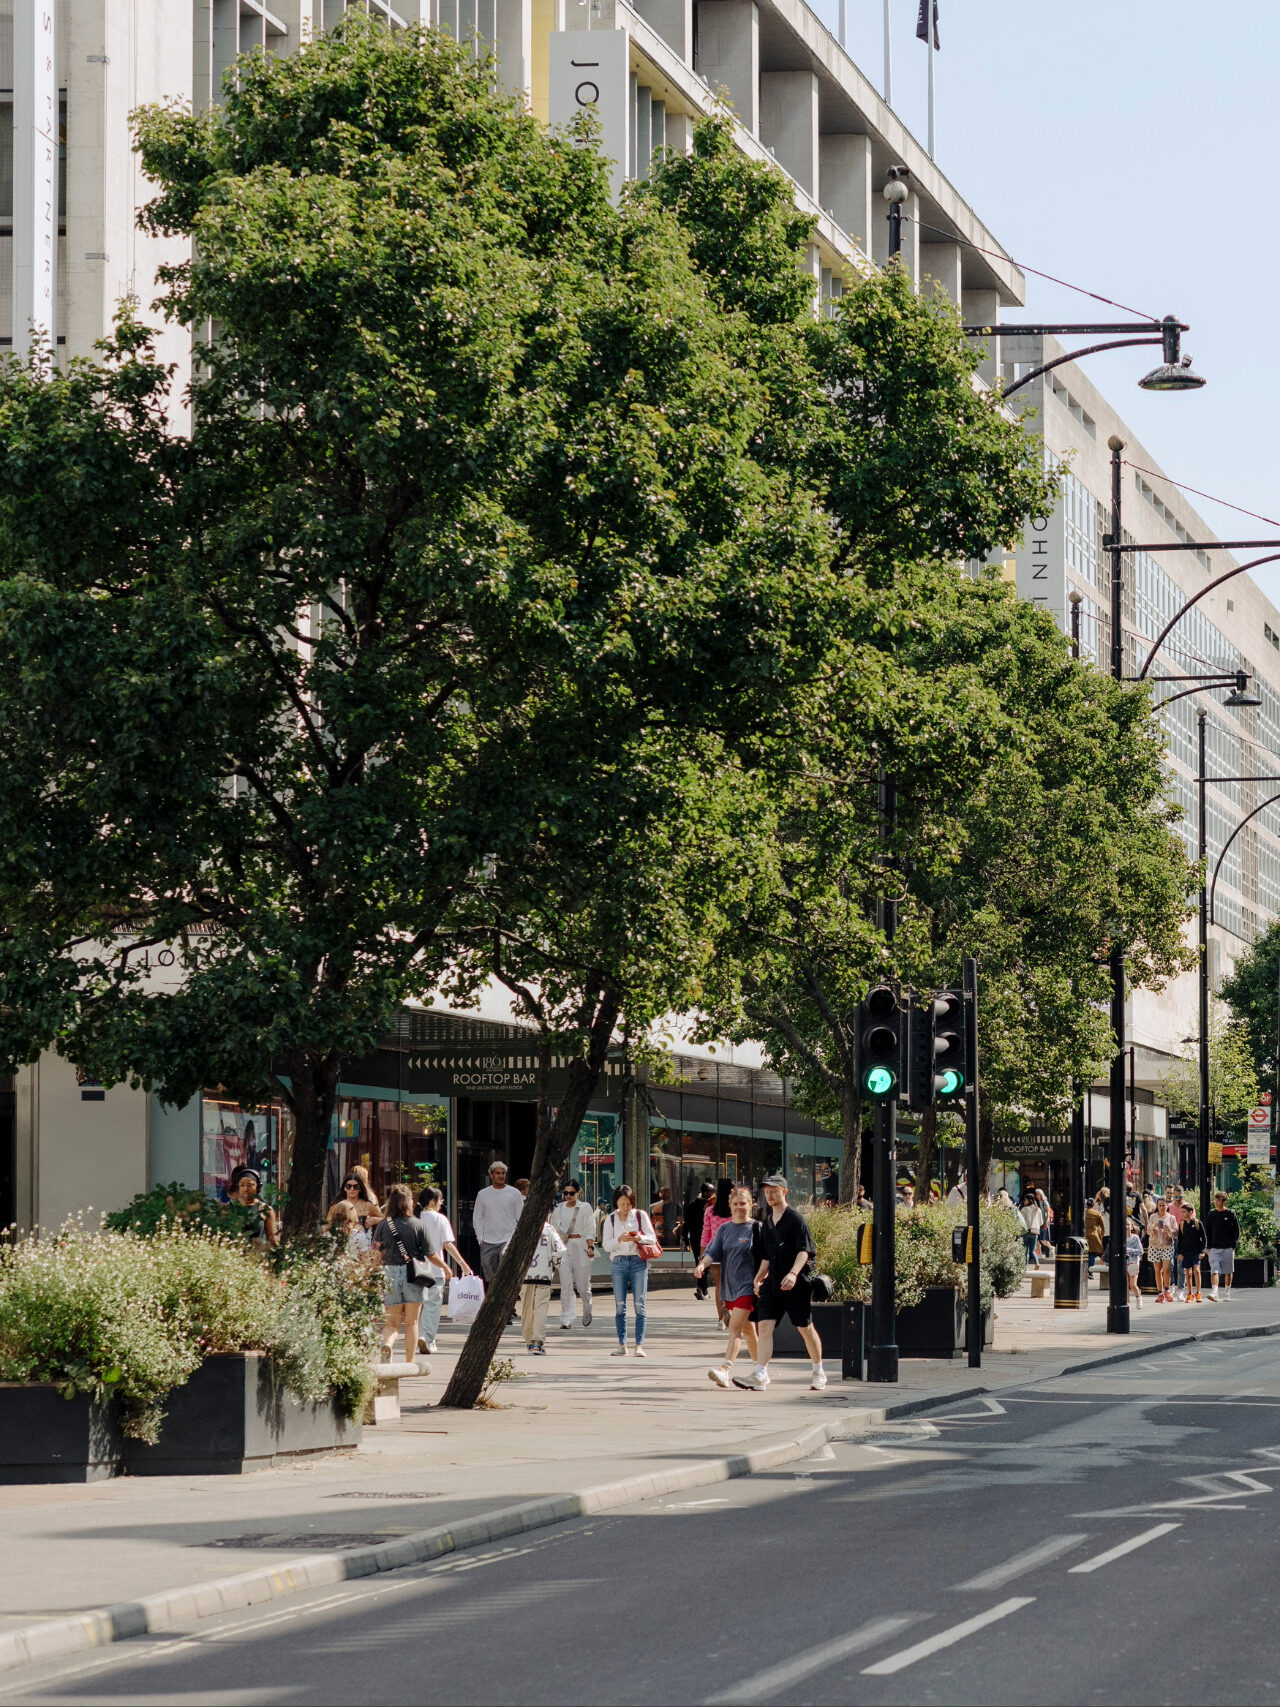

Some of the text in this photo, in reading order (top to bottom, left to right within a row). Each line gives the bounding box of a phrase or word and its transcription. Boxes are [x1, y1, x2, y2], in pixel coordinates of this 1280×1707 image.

[453, 1073, 536, 1085] ROOFTOP BAR
[1003, 1145, 1054, 1153] ROOFTOP BAR
